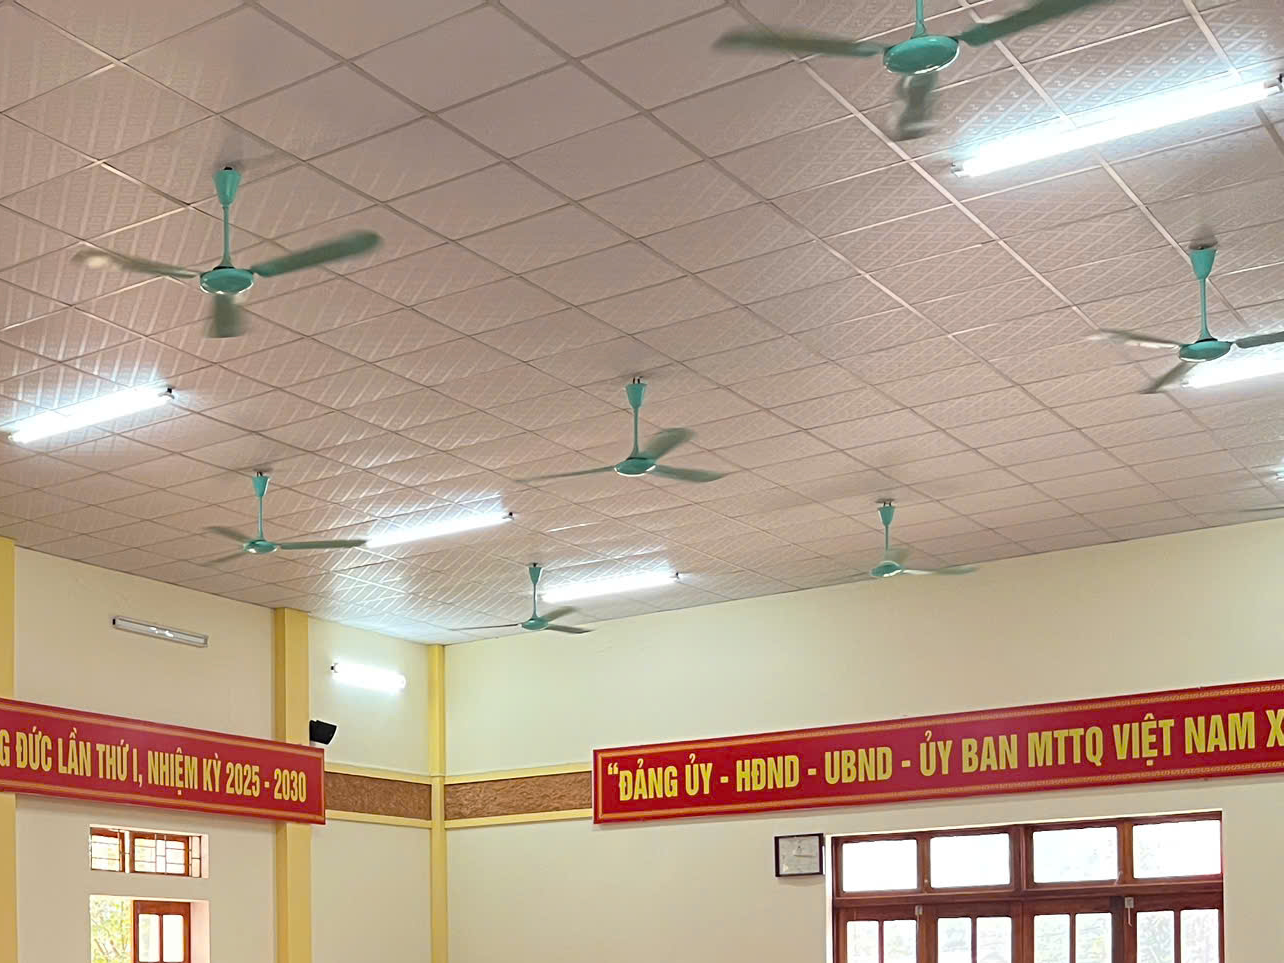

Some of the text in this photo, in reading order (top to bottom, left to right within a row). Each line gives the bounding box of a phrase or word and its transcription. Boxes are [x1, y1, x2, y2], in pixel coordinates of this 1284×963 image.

[16, 726, 52, 771] ĐỨC
[58, 728, 91, 776] LẦN
[96, 739, 129, 781] THỨ
[133, 748, 142, 787] I,
[147, 748, 198, 795] NHIỆM
[203, 753, 221, 792] KỲ
[226, 762, 260, 797] 2025
[274, 768, 306, 802] 2030
[685, 753, 712, 795] ỦY
[737, 755, 799, 792] HĐND
[825, 747, 892, 784] UBND
[920, 730, 952, 776] ỦY
[962, 734, 1017, 772] BAN
[1028, 727, 1103, 767] MTTQ
[1113, 713, 1174, 765] VIỆT
[1185, 712, 1255, 754] NAM
